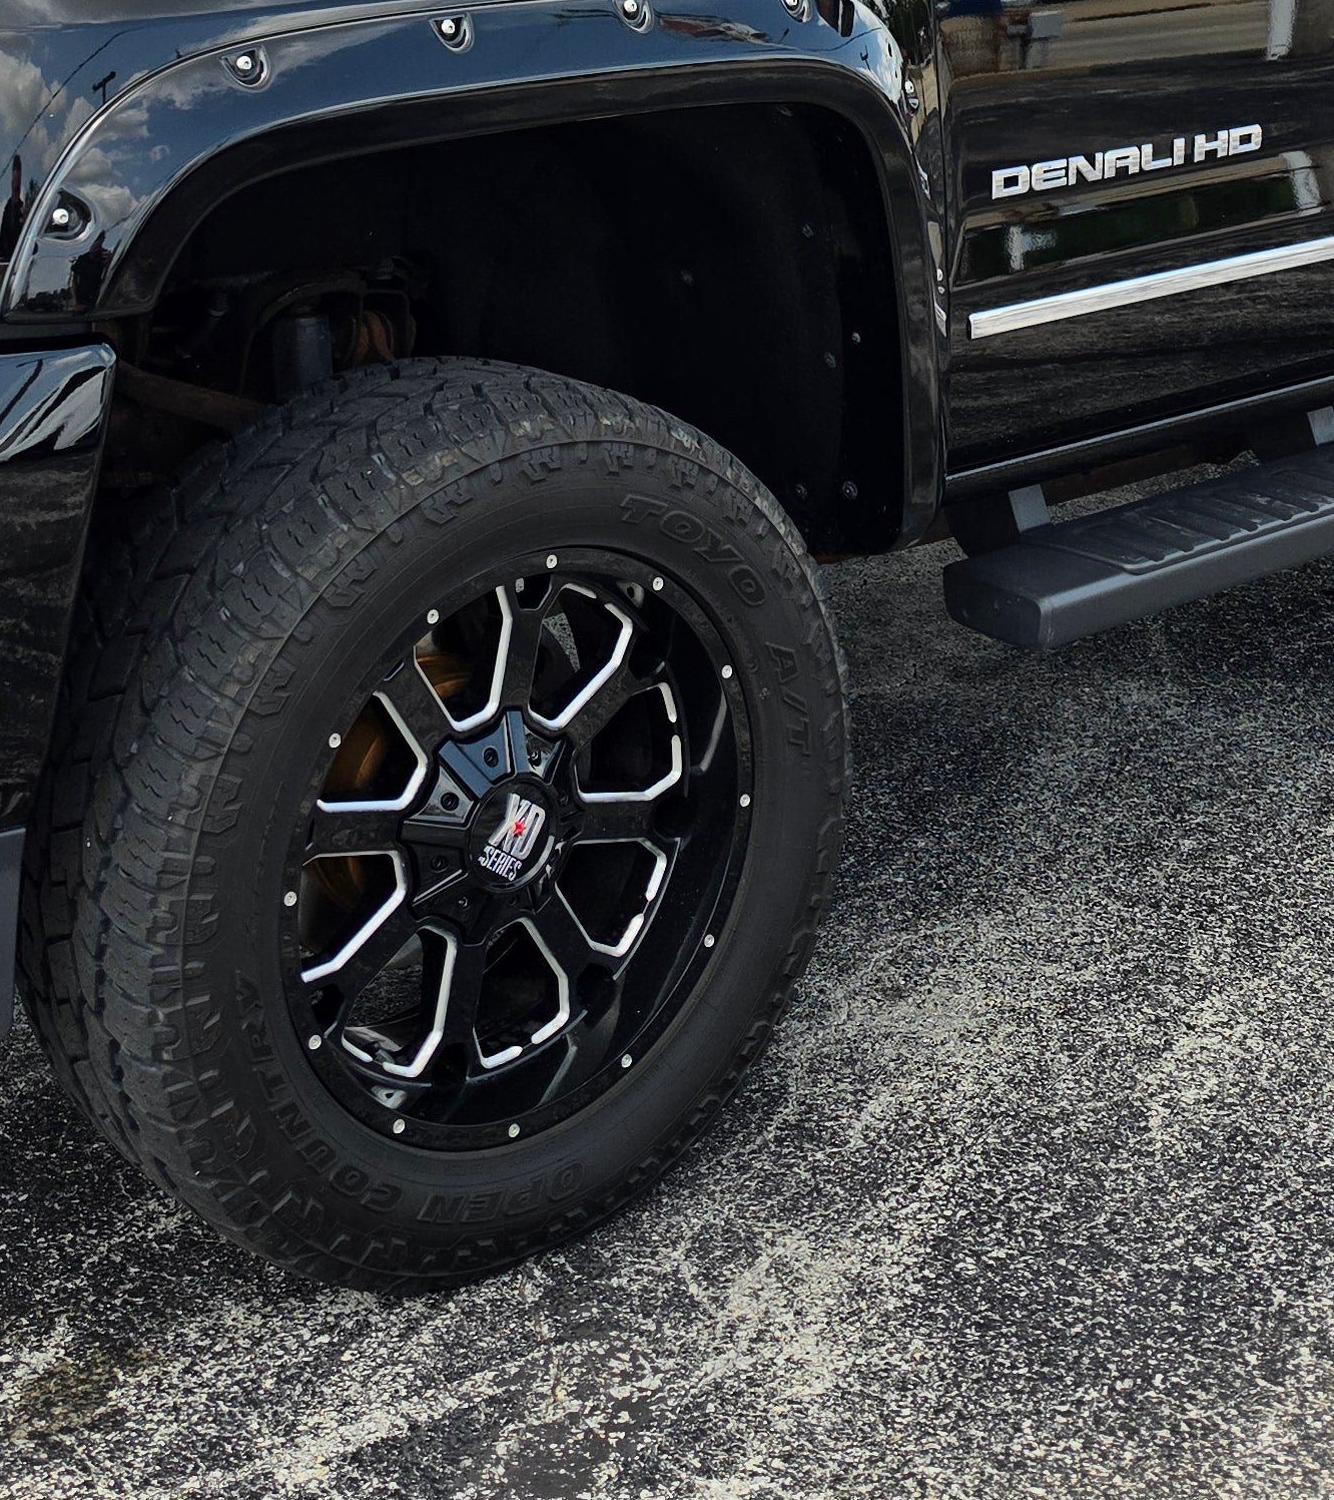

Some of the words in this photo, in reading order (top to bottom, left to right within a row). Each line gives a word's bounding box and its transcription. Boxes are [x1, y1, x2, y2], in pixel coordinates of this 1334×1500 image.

[991, 137, 1186, 199] DENALI
[1193, 123, 1263, 163] HD
[619, 493, 767, 607] TOYO
[763, 641, 813, 757] A/T
[478, 845, 522, 881] SERIES
[234, 967, 404, 1215] COUNTRY
[416, 1158, 587, 1226] OPEN
